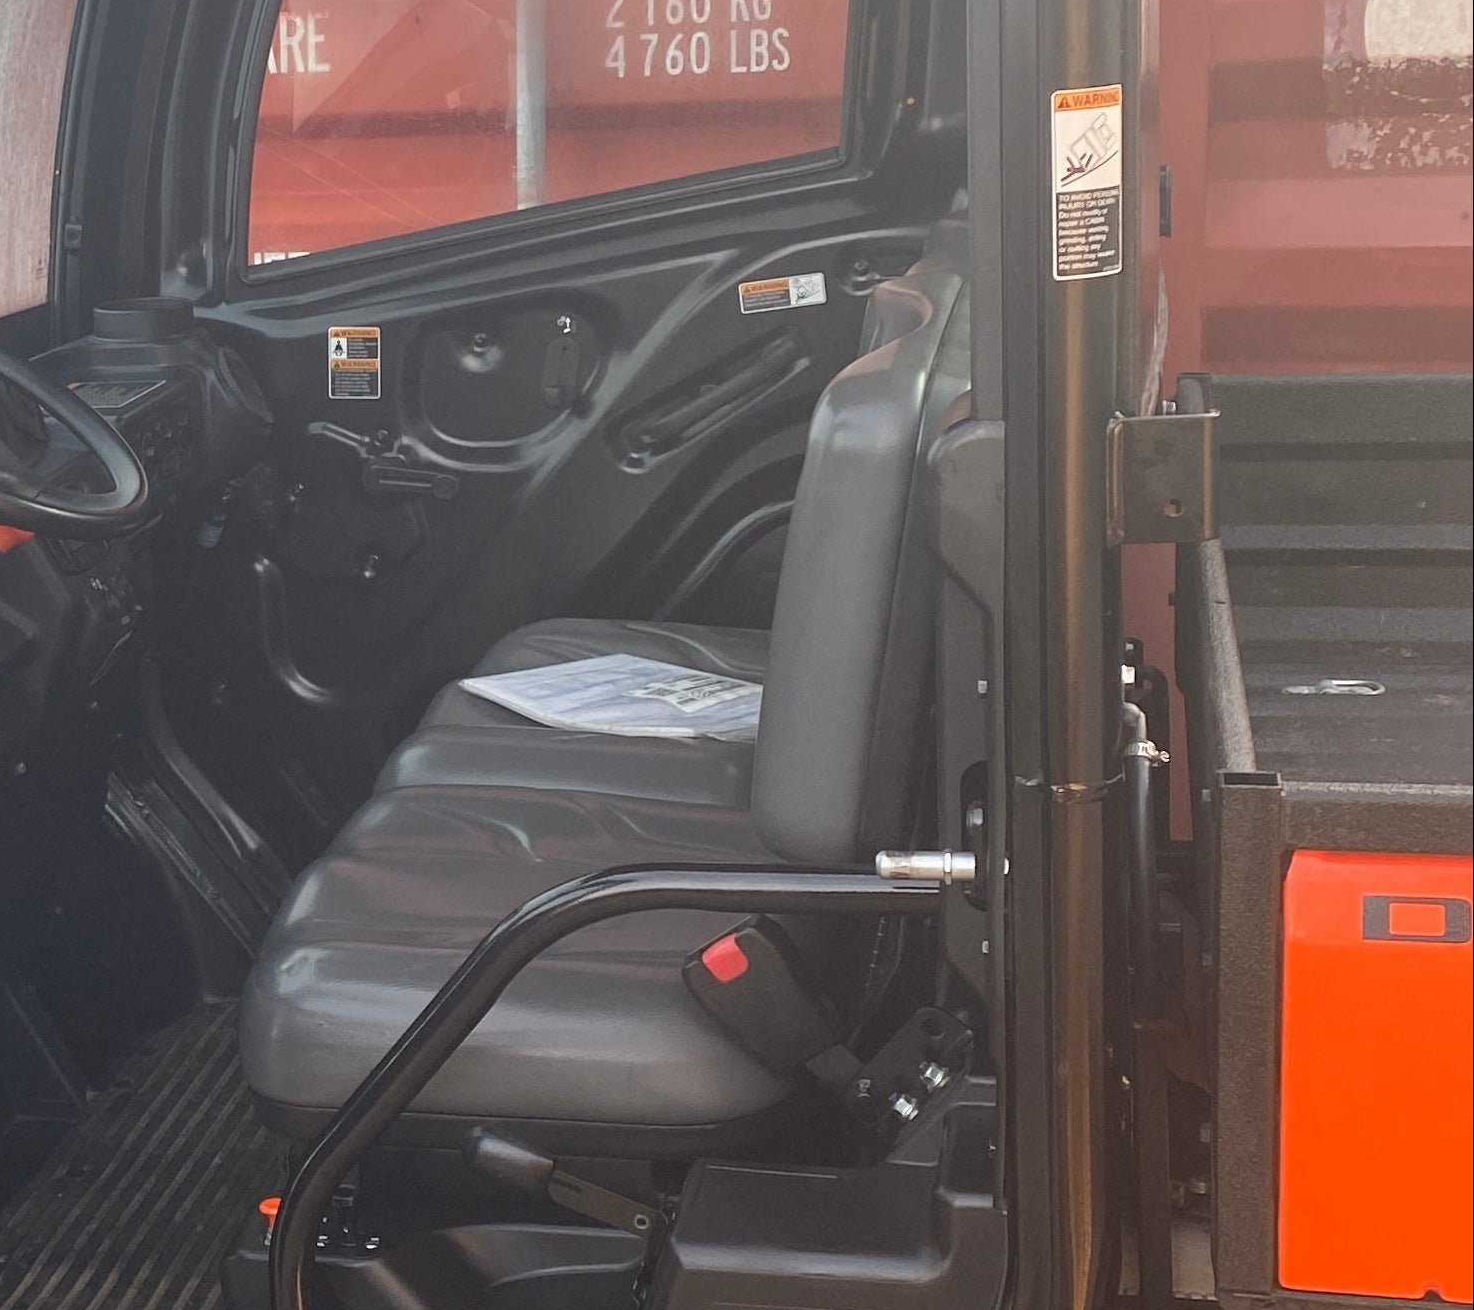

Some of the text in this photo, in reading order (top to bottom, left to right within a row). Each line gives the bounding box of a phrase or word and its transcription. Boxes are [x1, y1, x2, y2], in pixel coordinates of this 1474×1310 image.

[267, 11, 331, 75] RE
[605, 27, 791, 78] 4 760 LBS
